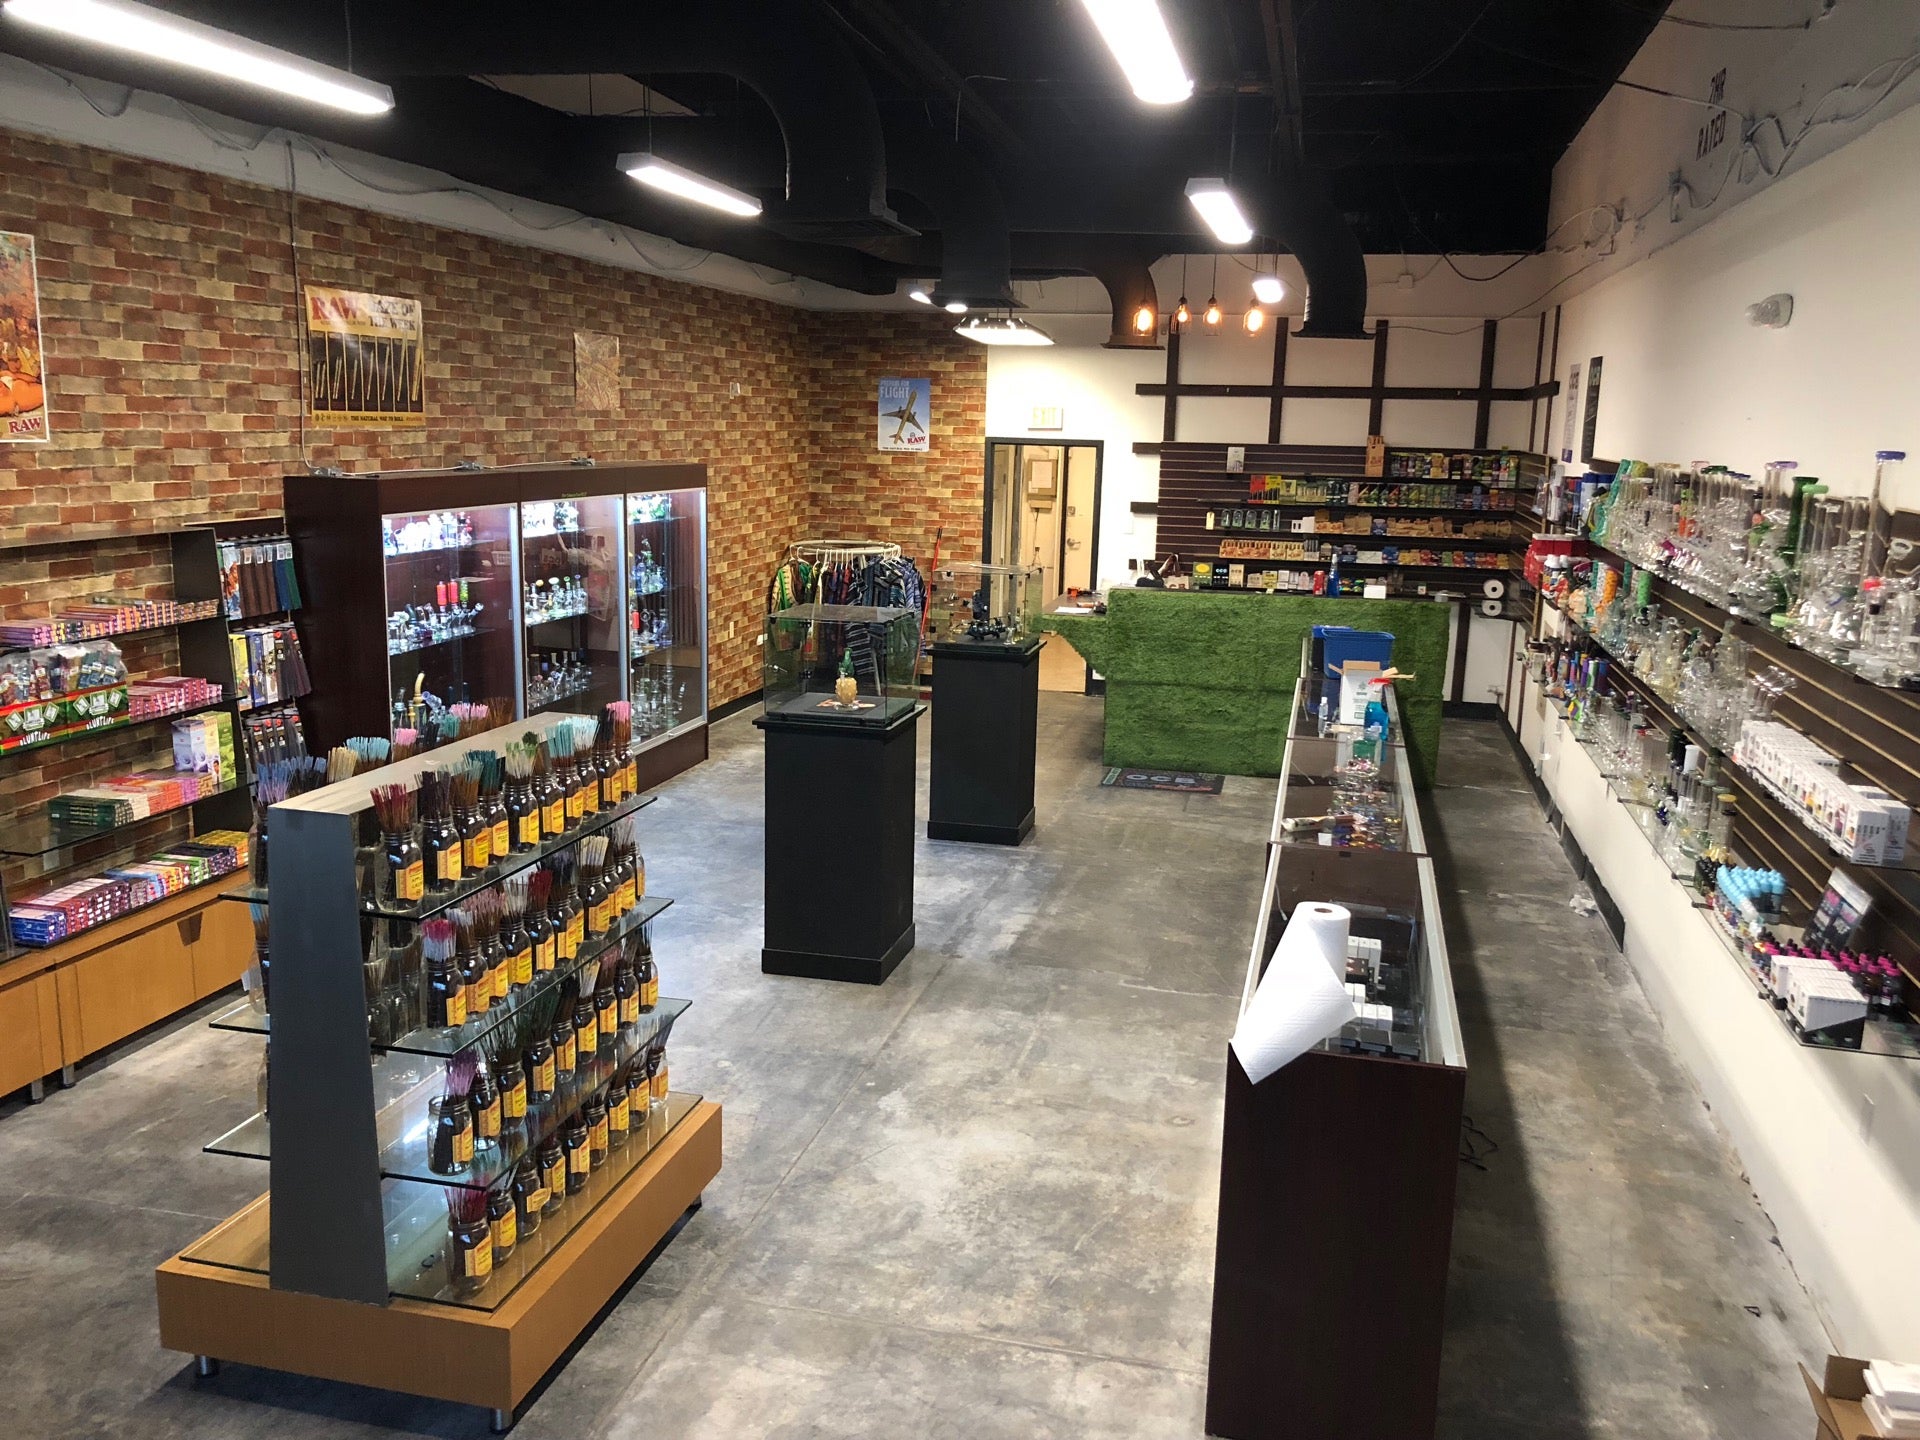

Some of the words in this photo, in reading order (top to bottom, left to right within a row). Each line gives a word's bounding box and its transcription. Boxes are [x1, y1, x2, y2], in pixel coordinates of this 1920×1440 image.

[1696, 110, 1727, 161] RATED
[310, 296, 359, 321] RAW
[880, 386, 909, 398] FLIGHT
[1032, 407, 1057, 425] EXIT
[9, 417, 41, 433] RAW
[907, 436, 926, 444] RAW
